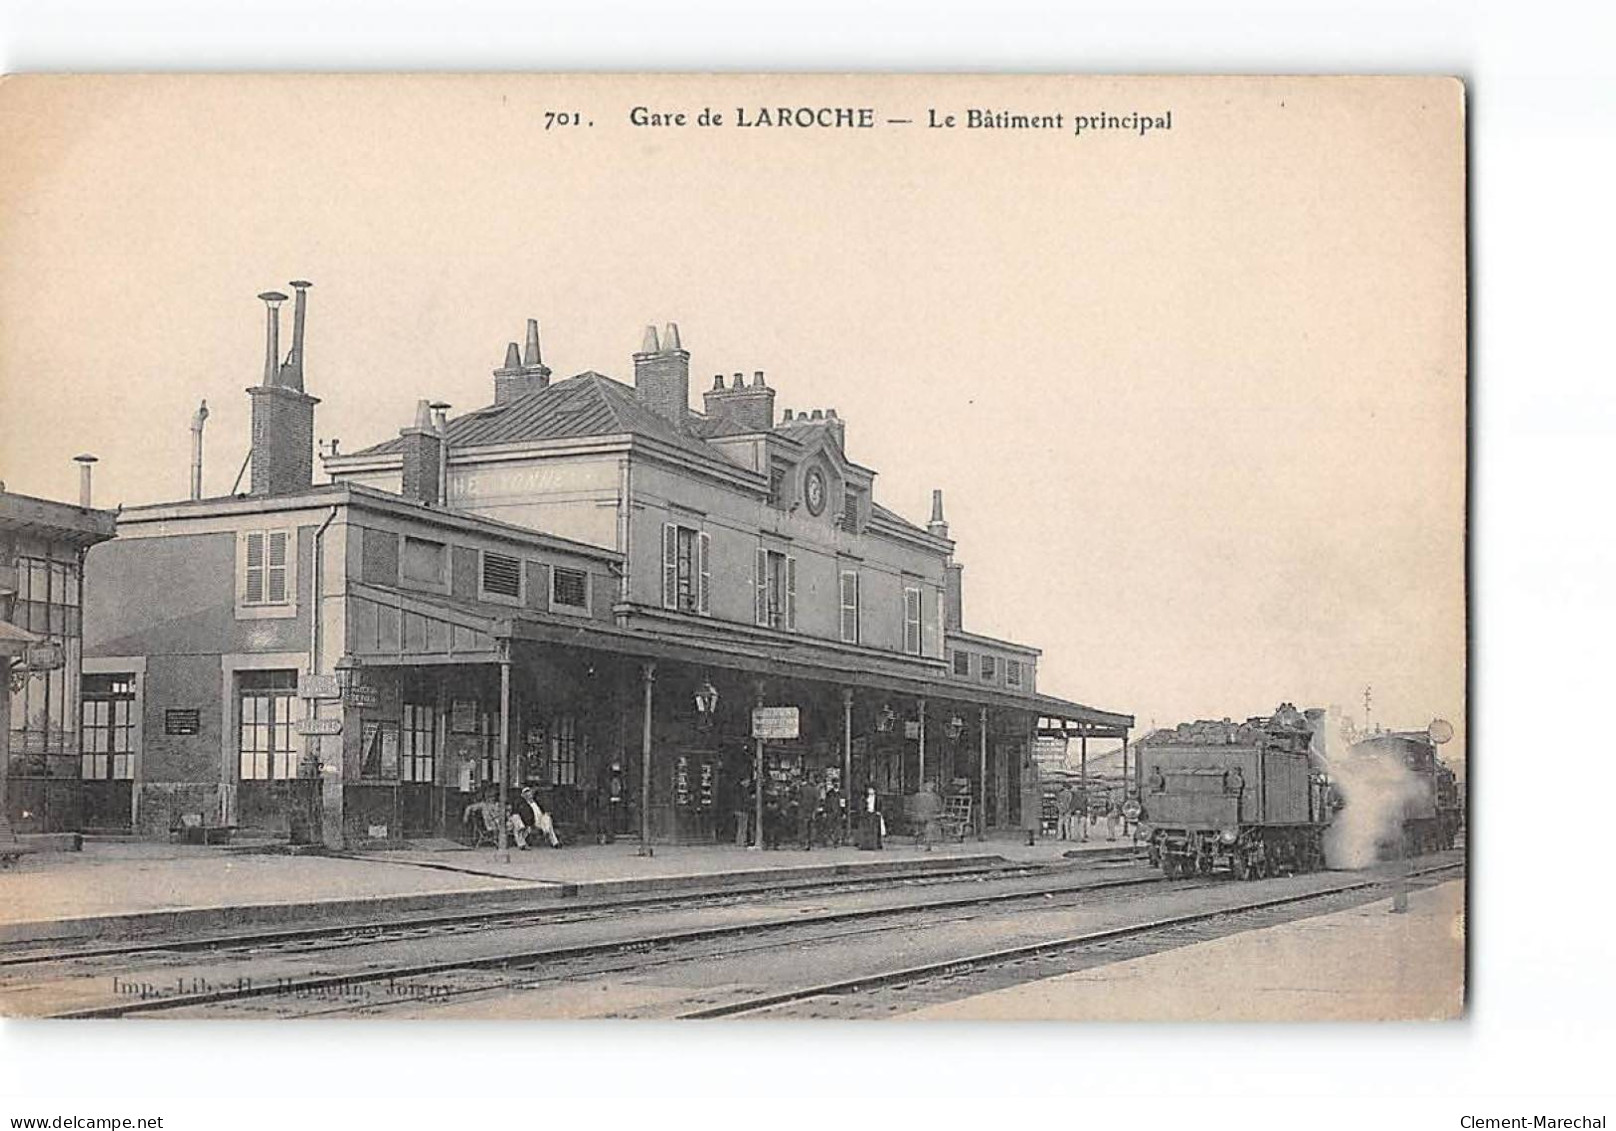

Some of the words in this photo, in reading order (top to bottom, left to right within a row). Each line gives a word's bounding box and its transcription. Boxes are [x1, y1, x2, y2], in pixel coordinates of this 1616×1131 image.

[544, 111, 594, 130] 701.
[629, 106, 686, 127] Gare
[697, 107, 723, 127] de
[736, 107, 874, 128] LAROCHE
[928, 108, 955, 128] Le
[967, 109, 1064, 129] Bâtiment
[1074, 111, 1172, 136] principal
